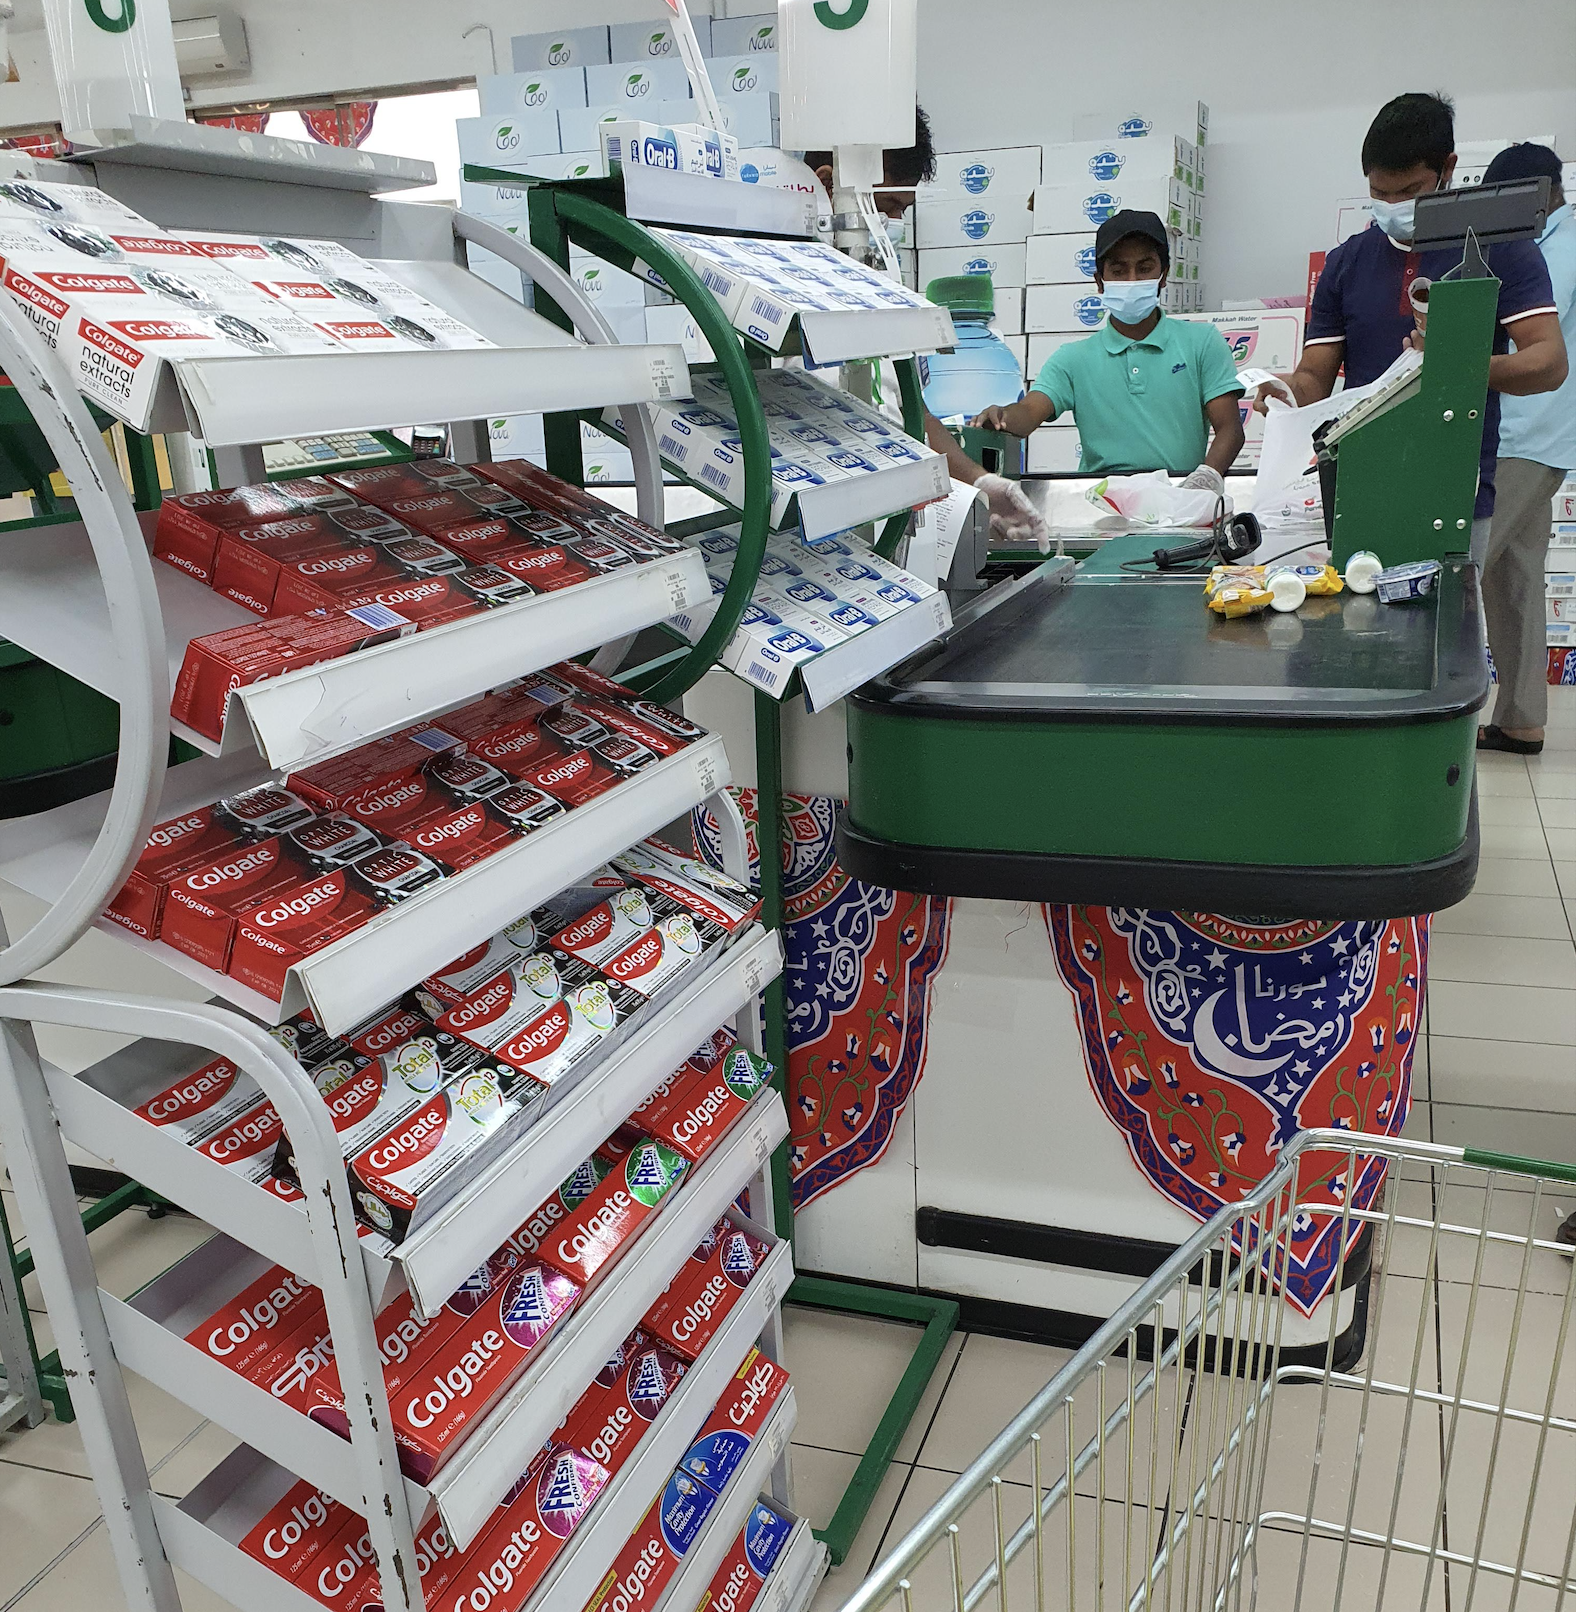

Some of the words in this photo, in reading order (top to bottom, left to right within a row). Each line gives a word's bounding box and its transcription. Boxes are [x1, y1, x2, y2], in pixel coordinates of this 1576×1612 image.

[646, 142, 675, 169] Oral-B
[11, 275, 66, 314] Colgate
[53, 275, 134, 292] Colgate
[281, 284, 327, 298] olgate
[84, 324, 141, 364] Colgate
[80, 361, 132, 398] extracts
[82, 345, 135, 385] natural
[773, 466, 807, 481] Oral-B
[832, 453, 863, 469] Oral-B
[392, 496, 453, 513] Colgate
[239, 519, 316, 542] Colgate
[447, 524, 506, 543] Colgate
[706, 536, 737, 552] Oral-B
[167, 552, 208, 579] Colgate
[298, 552, 373, 575] Colgate
[507, 551, 564, 571] Colgate
[839, 564, 869, 580] Oral-B
[228, 588, 268, 614] Colgate
[375, 581, 445, 606] Colgate
[793, 581, 824, 600] Oral-B
[880, 586, 907, 602] Oral-B
[833, 606, 864, 624] Oral-B
[772, 633, 808, 653] Oral-B
[590, 707, 669, 750] Colgate
[484, 732, 539, 758] Colgate
[450, 765, 484, 783] WHITE
[537, 757, 590, 786] Colgate
[355, 783, 424, 816] Colgate
[505, 793, 539, 811] WHITE
[300, 819, 339, 841] OPTIC
[308, 826, 351, 846] WHITE
[416, 811, 482, 847] Colgate
[187, 849, 275, 890] Colgate
[363, 851, 402, 873] OPTIC
[372, 857, 414, 879] WHITE
[170, 889, 216, 918] Colgate
[255, 881, 341, 928] Colgate
[617, 897, 644, 915] Total
[654, 880, 729, 924] Colgate
[240, 927, 286, 955] Colgate
[560, 911, 609, 947] Colgate
[541, 954, 552, 963] 12
[612, 939, 660, 976] Colgate
[519, 962, 553, 987] Total
[596, 983, 607, 992] 12
[449, 982, 510, 1027] Colgate
[575, 990, 609, 1015] Total
[422, 1039, 434, 1049] 12
[508, 1013, 567, 1060] Colgate
[391, 1047, 434, 1078] Total
[483, 1071, 495, 1081] 12
[729, 1054, 753, 1084] FRESH
[147, 1064, 232, 1119] Colgate
[456, 1079, 496, 1112] Total
[672, 1085, 730, 1142] Colgate
[209, 1107, 280, 1158] Colgat
[368, 1110, 444, 1169] Colgate
[630, 1150, 661, 1186] FRESH
[557, 1188, 632, 1264] Colgate
[725, 1237, 750, 1271] FRESH
[504, 1275, 542, 1322] FRESH
[671, 1275, 728, 1342] Colgate
[407, 1330, 505, 1428] Colgate
[630, 1357, 661, 1400] FRESH
[729, 1362, 774, 1426] كولجيت
[436, 1427, 449, 1443] 125ml
[453, 1409, 467, 1426] (166g)
[581, 1406, 633, 1465] lgate
[542, 1458, 574, 1513] FRESH
[664, 1494, 686, 1525] Maximum
[670, 1510, 685, 1530] Cavity
[674, 1504, 696, 1537] Protection
[748, 1523, 766, 1551] Maximum
[757, 1532, 775, 1561] Protection
